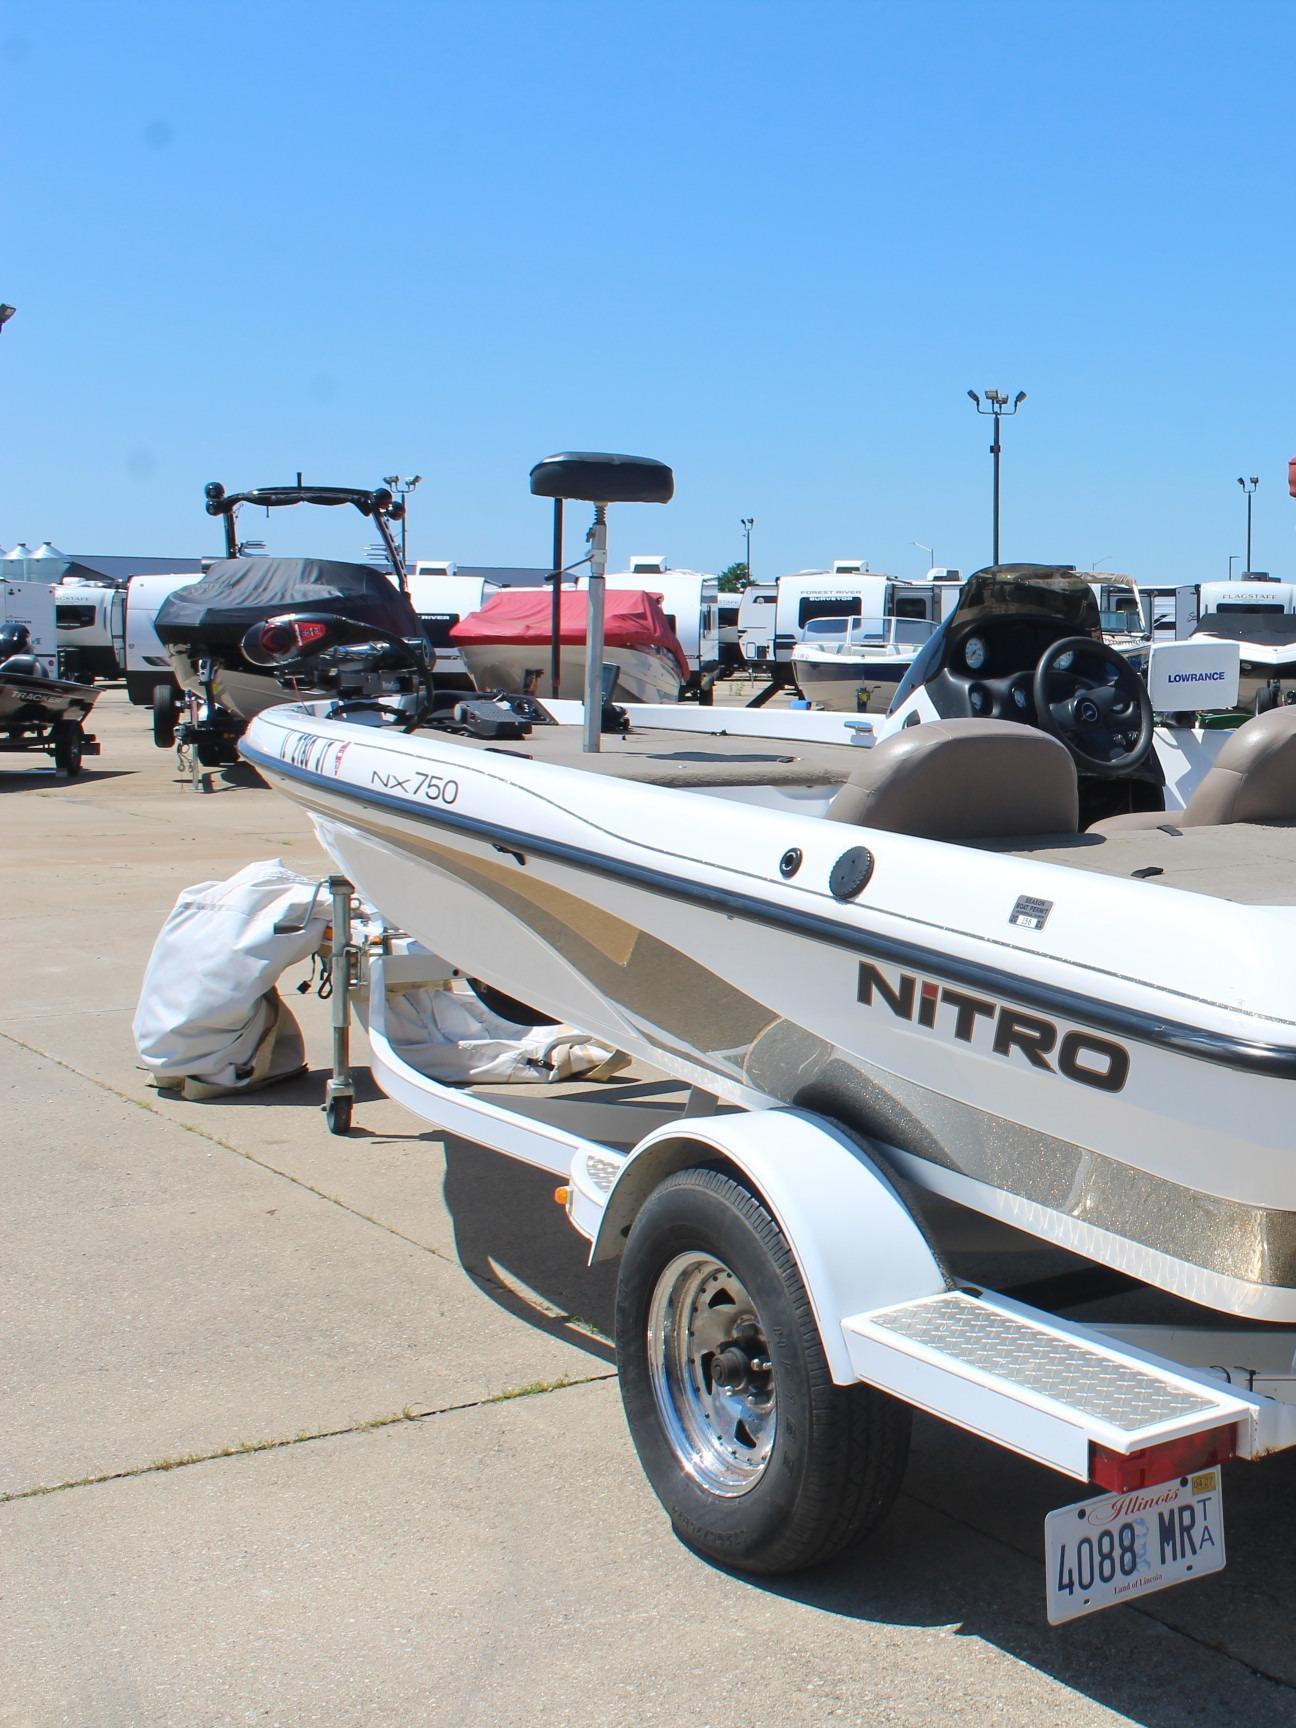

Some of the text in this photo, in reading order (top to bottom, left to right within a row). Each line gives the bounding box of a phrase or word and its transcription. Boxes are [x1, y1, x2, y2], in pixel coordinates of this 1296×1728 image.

[1168, 672, 1225, 683] LOWRANCE
[1088, 1487, 1181, 1525] Illinois
[1057, 1505, 1197, 1596] 4088 MR
